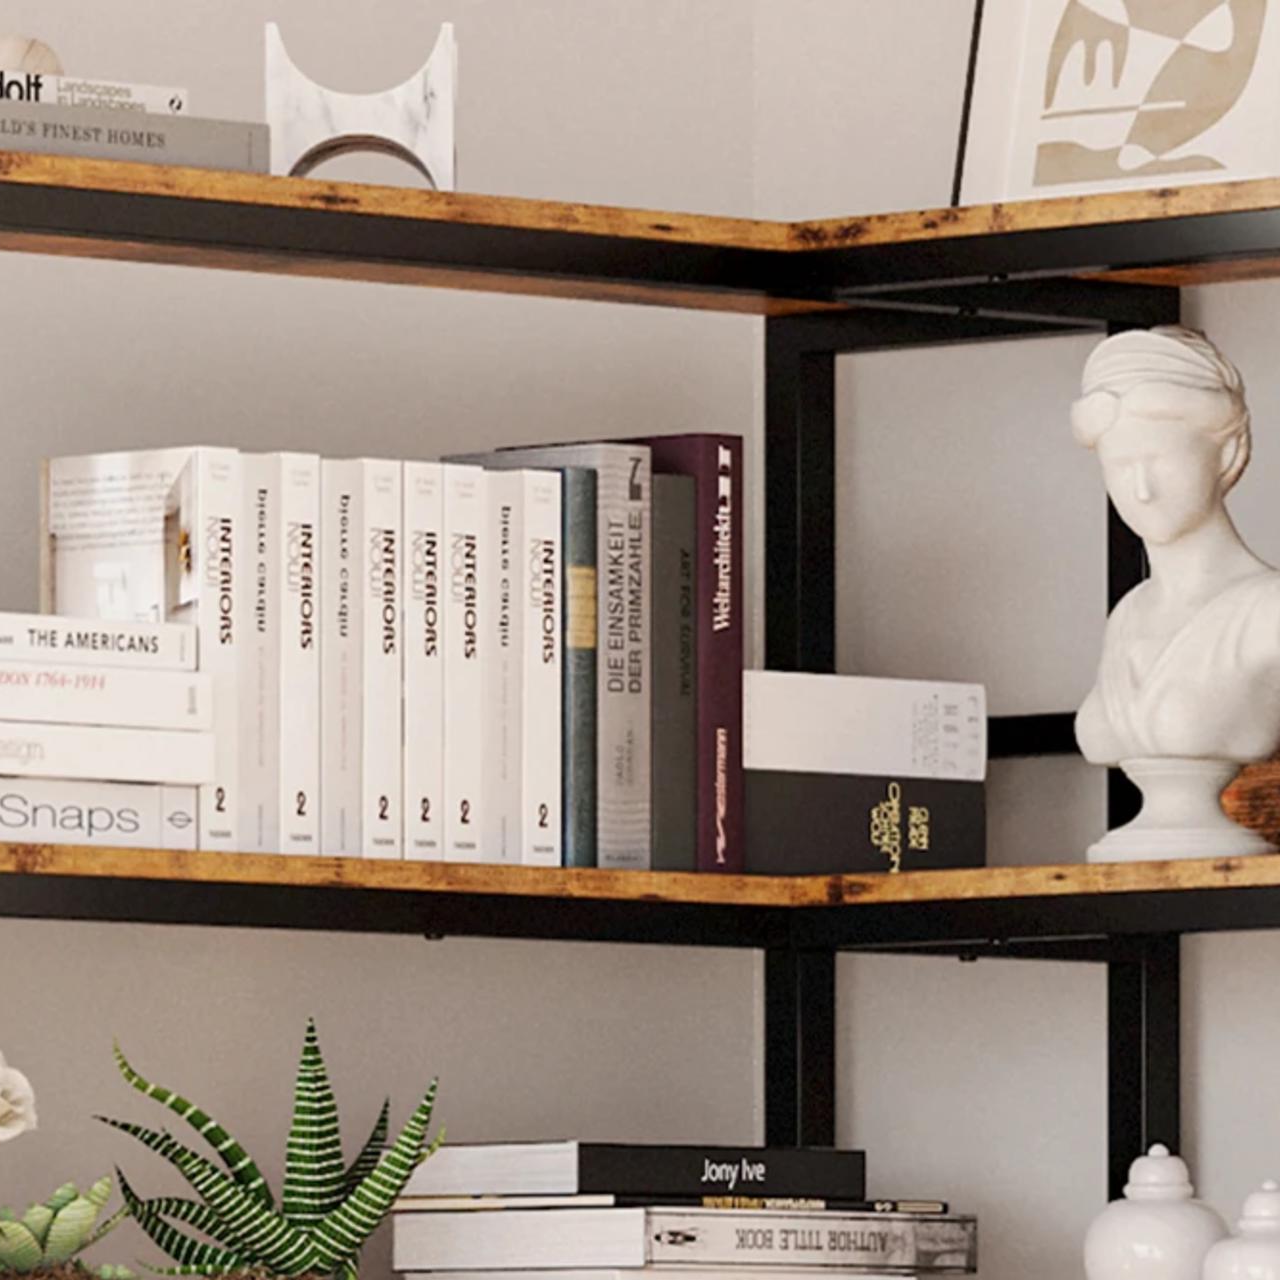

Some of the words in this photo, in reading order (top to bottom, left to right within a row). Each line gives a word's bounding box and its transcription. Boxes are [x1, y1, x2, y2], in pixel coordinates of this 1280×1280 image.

[42, 122, 103, 144] FINEST
[108, 128, 166, 149] HOMES
[220, 517, 232, 645] INTERIORS
[301, 523, 313, 650] INTERIORS
[383, 530, 396, 654] INTERIORS
[425, 532, 437, 656] INTERIORS
[608, 520, 625, 655] EINSAMKEIT
[465, 535, 477, 659] INTERIORS
[543, 540, 555, 664] INTERIORS
[28, 629, 57, 647] THE
[65, 632, 160, 654] AMERICANS
[608, 661, 625, 694] DIE
[628, 650, 643, 694] DER
[215, 786, 226, 812] 2
[296, 791, 307, 816] 2
[379, 795, 390, 820] 2
[420, 797, 431, 823] 2
[460, 799, 471, 824] 2
[538, 803, 549, 828] 2
[701, 1159, 738, 1189] Jony
[741, 1160, 765, 1181] Ive
[735, 1228, 774, 1250] BOOK
[780, 1228, 823, 1251] TITLE
[828, 1230, 888, 1252] AUTHOR
